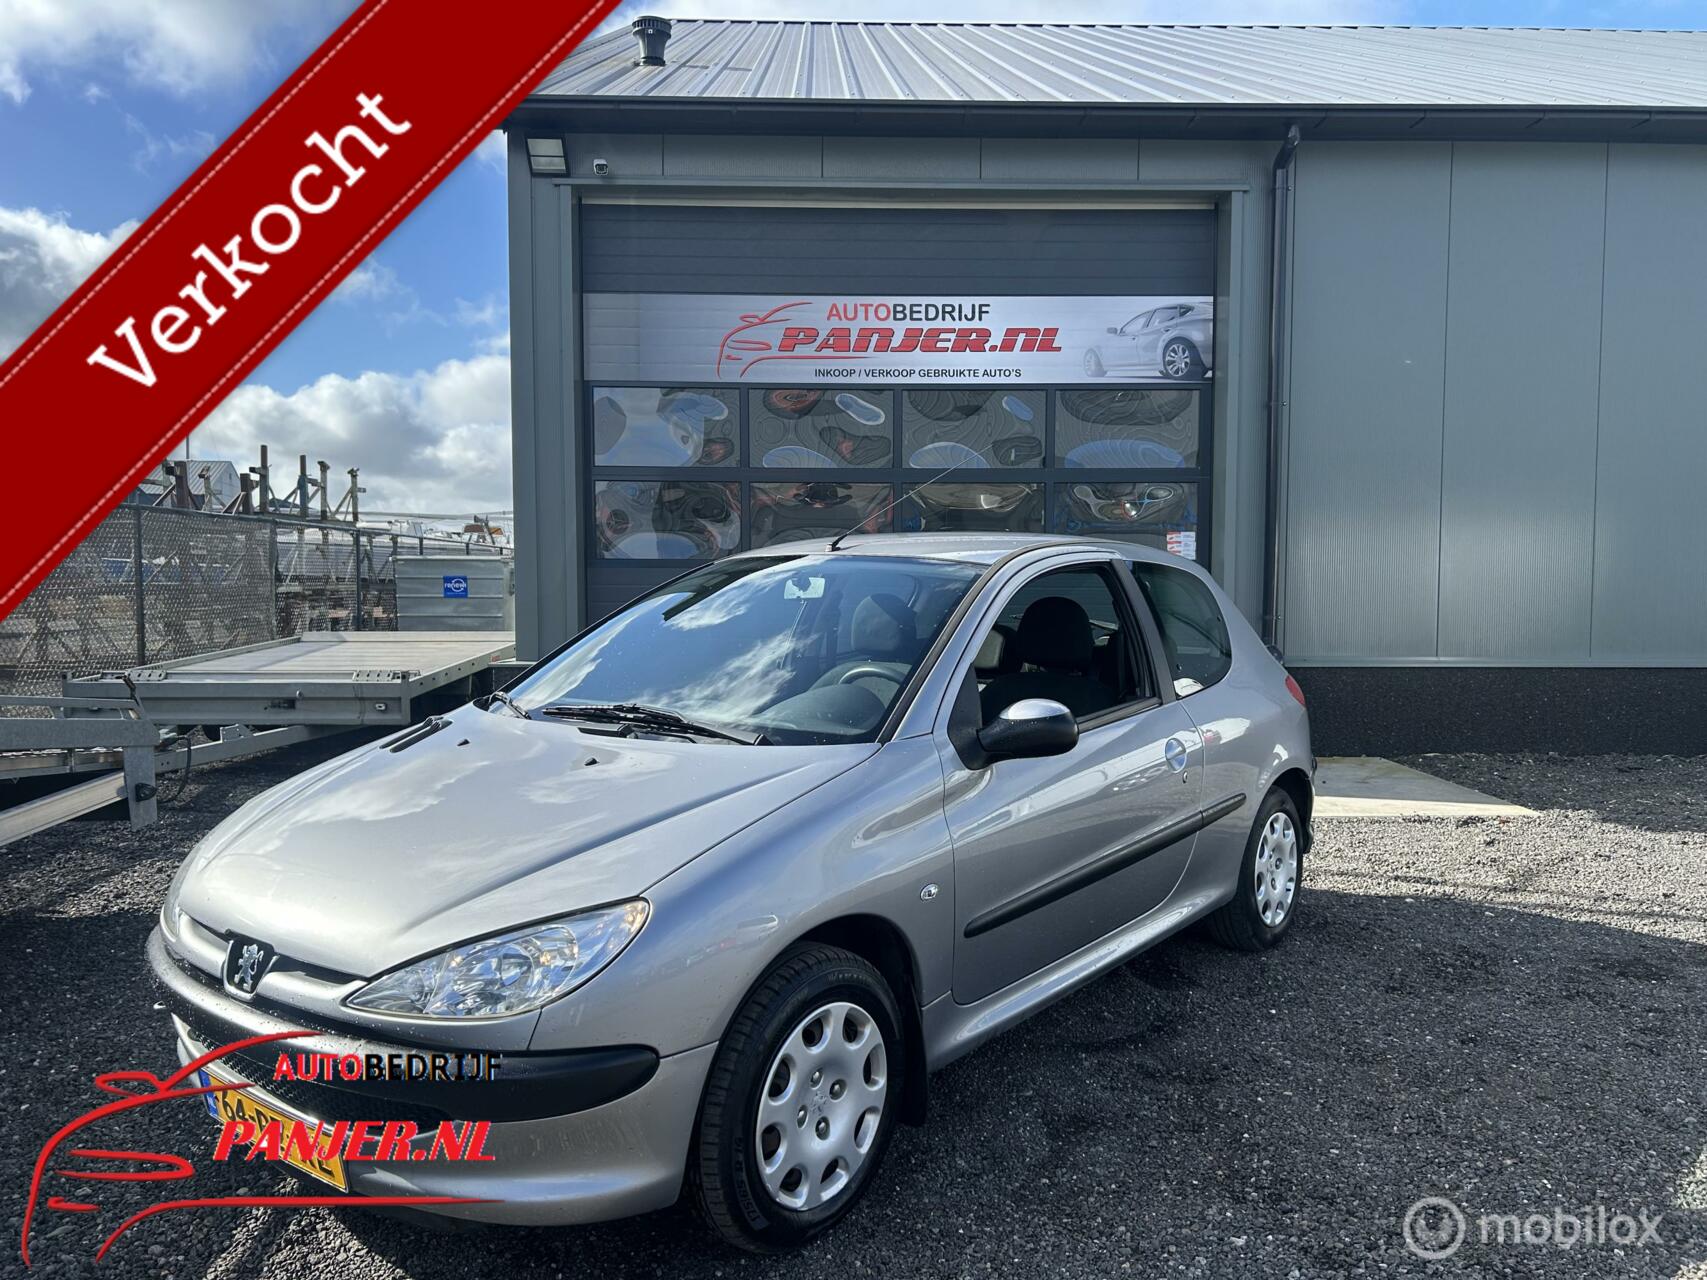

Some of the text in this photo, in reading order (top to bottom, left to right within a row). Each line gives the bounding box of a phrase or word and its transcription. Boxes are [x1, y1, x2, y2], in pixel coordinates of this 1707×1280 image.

[826, 303, 991, 322] AUTOBEDRIJF
[777, 327, 1062, 352] PANJER.NL
[814, 368, 857, 378] INKOOP
[863, 368, 916, 378] VERKOOP
[918, 368, 981, 378] GEBRUIKTE
[982, 368, 1022, 378] AUTO'S
